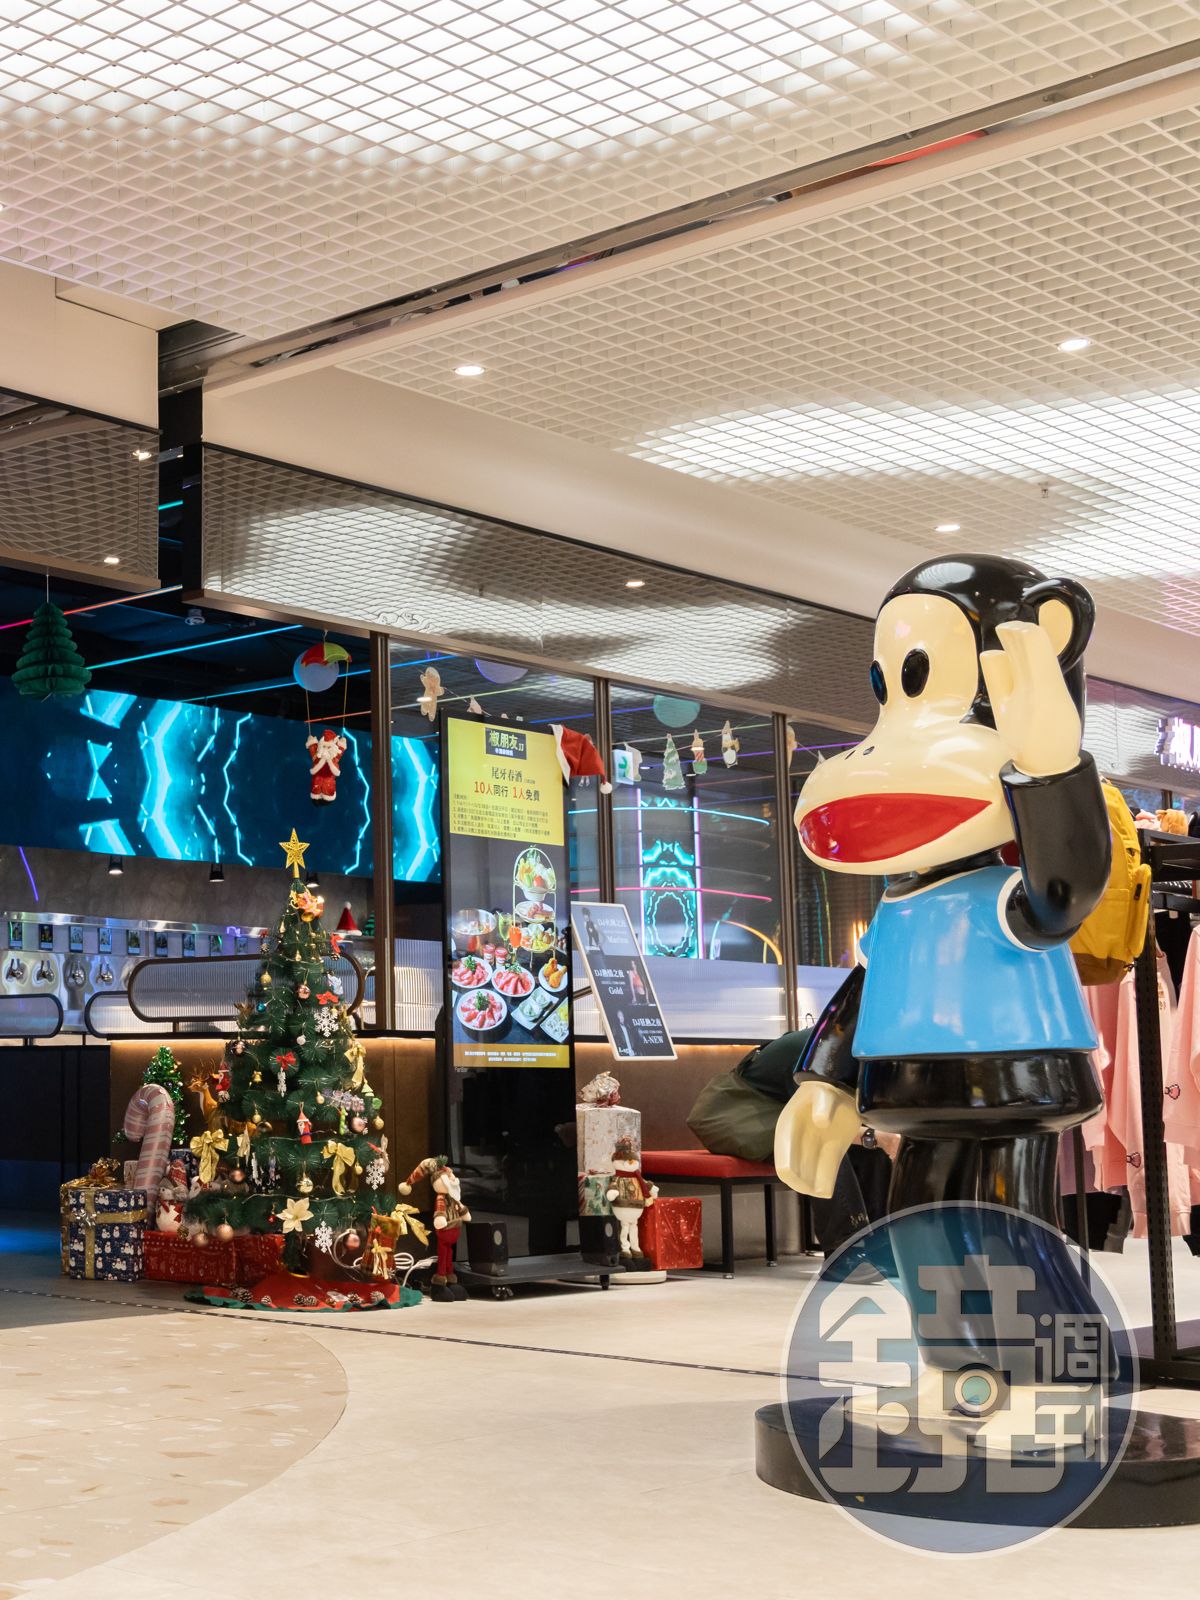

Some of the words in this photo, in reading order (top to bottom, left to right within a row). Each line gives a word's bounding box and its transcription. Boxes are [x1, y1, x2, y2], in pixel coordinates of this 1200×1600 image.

[491, 767, 523, 783] 尾牙春酒
[474, 781, 508, 798] 10人同行
[512, 786, 540, 801] 1人免費
[608, 986, 625, 995] Gold
[643, 1036, 664, 1044] A-NEW
